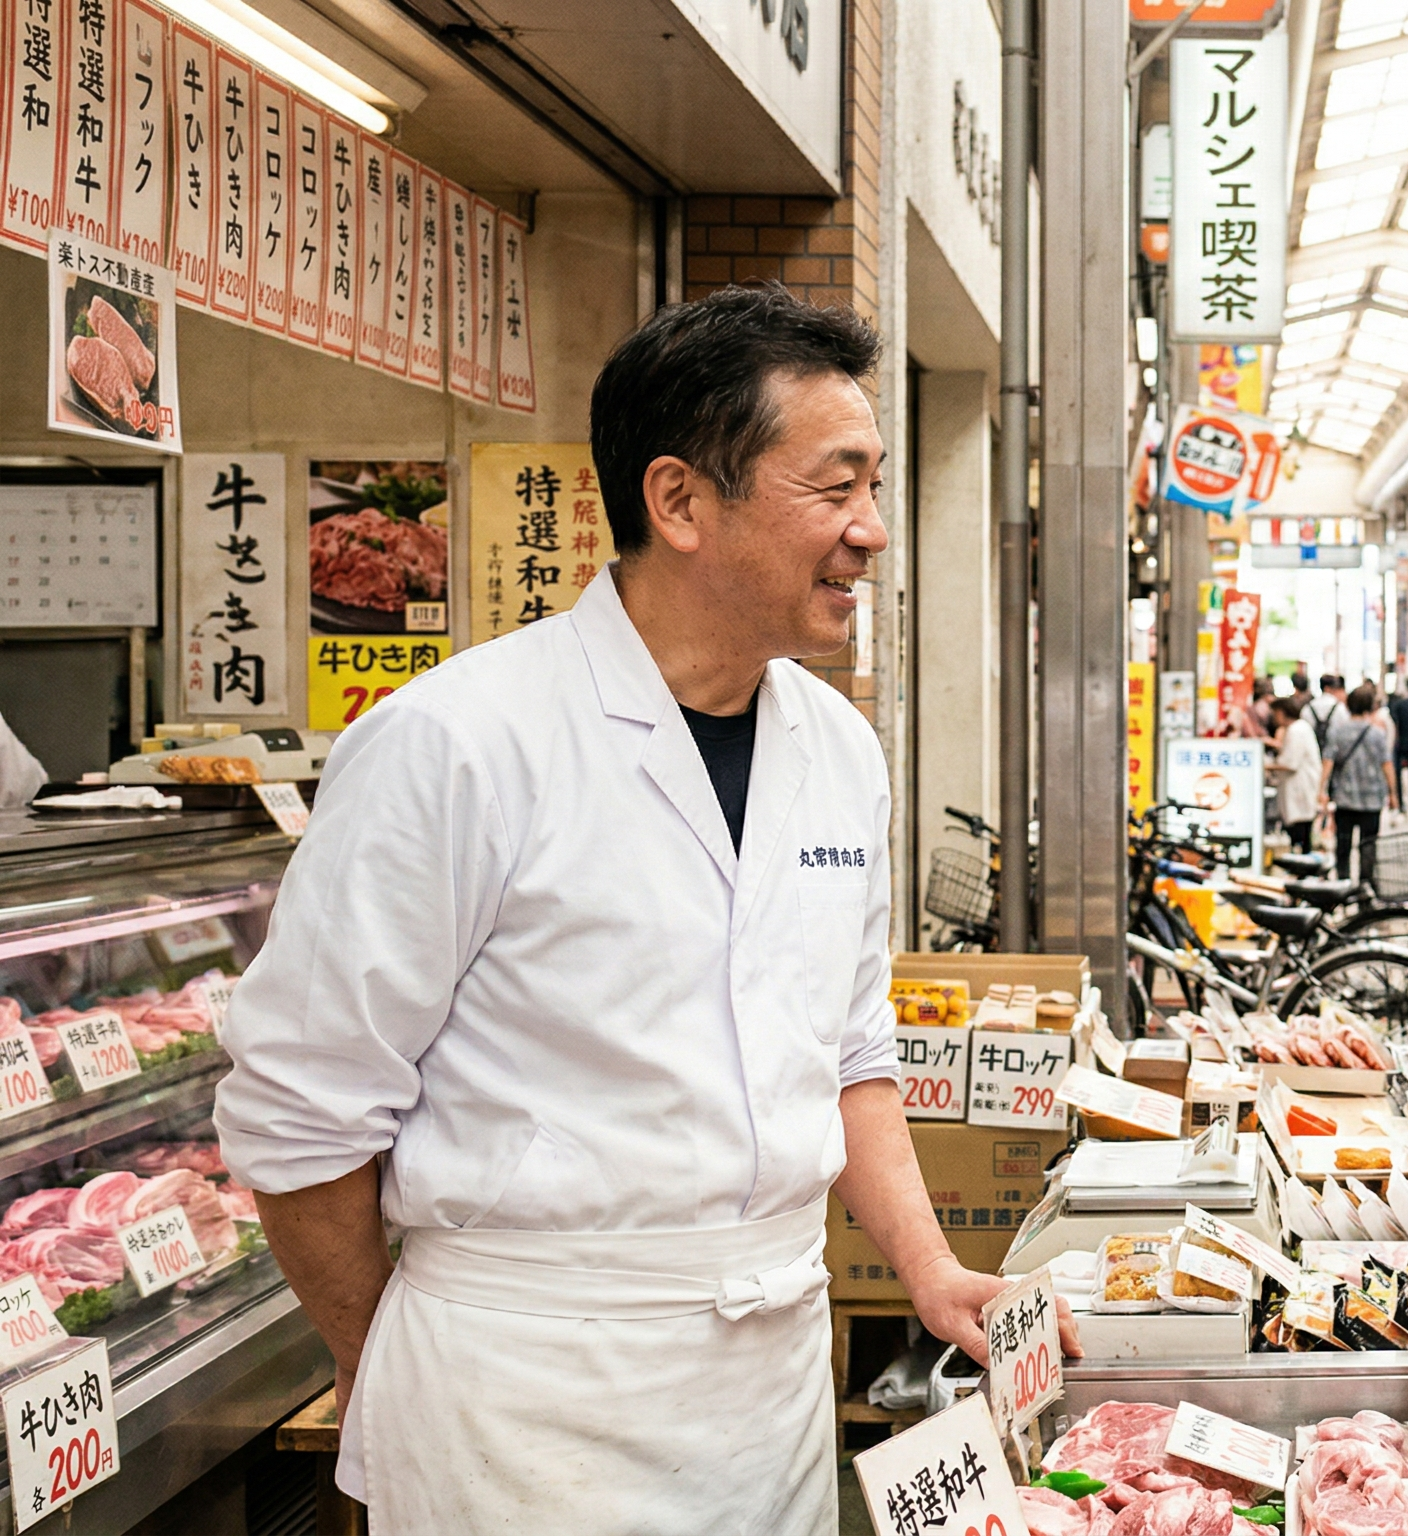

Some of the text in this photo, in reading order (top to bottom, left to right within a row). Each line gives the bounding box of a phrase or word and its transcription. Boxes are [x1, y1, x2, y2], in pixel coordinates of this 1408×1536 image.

[75, 0, 105, 204] 特選和牛
[183, 58, 204, 210] 牛ひき
[8, 184, 50, 230] ¥100
[225, 76, 244, 259] 牛ひき肉
[265, 105, 282, 258] コロッケ
[301, 125, 318, 271] コロッケ
[1200, 48, 1257, 323] マルシェ喫茶
[333, 137, 352, 300] 牛ひき肉
[175, 247, 205, 286] ¥100
[218, 264, 246, 301] ¥200
[257, 281, 285, 315] ¥200
[318, 641, 439, 674] 牛ひき肉
[979, 1043, 1064, 1076] 牛ロッケ
[20, 1369, 104, 1453] 牛ひき肉
[886, 1442, 988, 1536] 特選和牛
